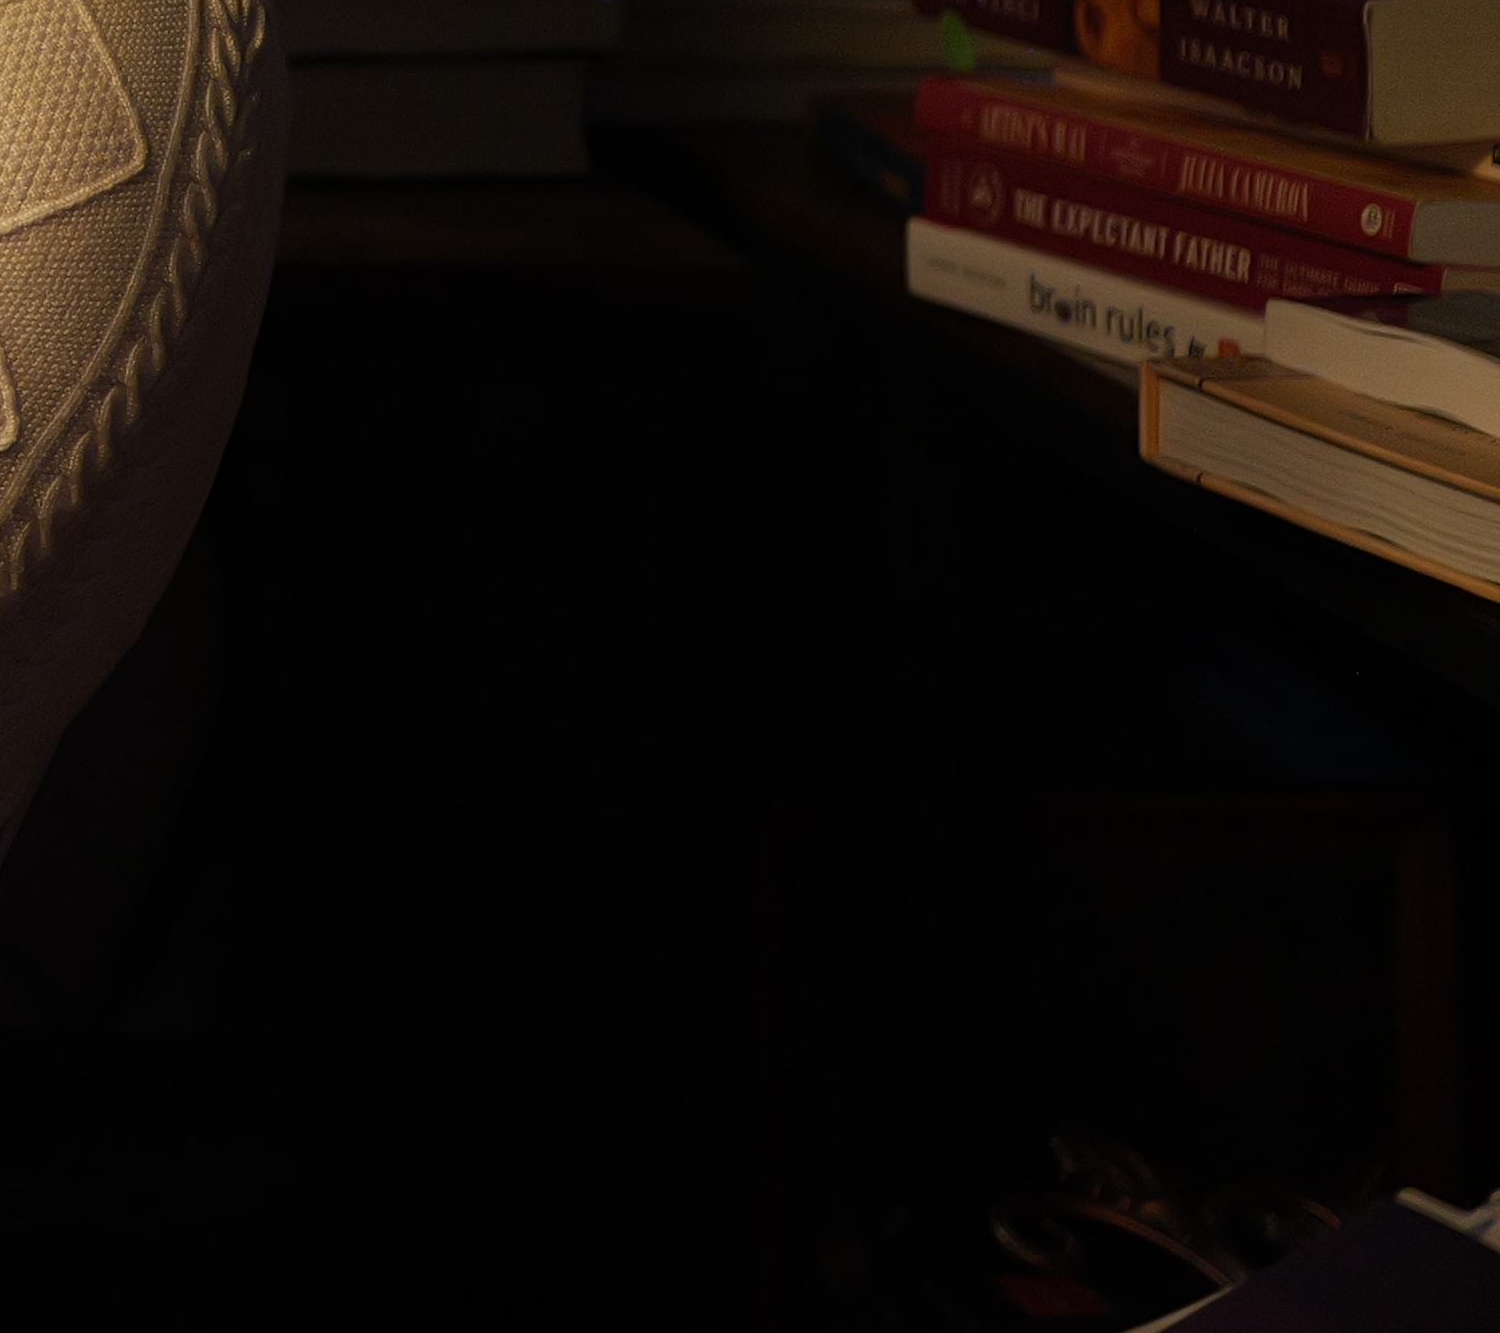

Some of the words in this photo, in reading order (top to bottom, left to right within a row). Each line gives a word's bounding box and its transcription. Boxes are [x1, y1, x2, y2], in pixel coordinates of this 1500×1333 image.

[1177, 36, 1304, 90] ISAACSON
[1012, 186, 1049, 230] THE
[1051, 196, 1170, 260] EXPECTANT
[1173, 230, 1253, 284] FATHER
[1106, 304, 1176, 359] rules
